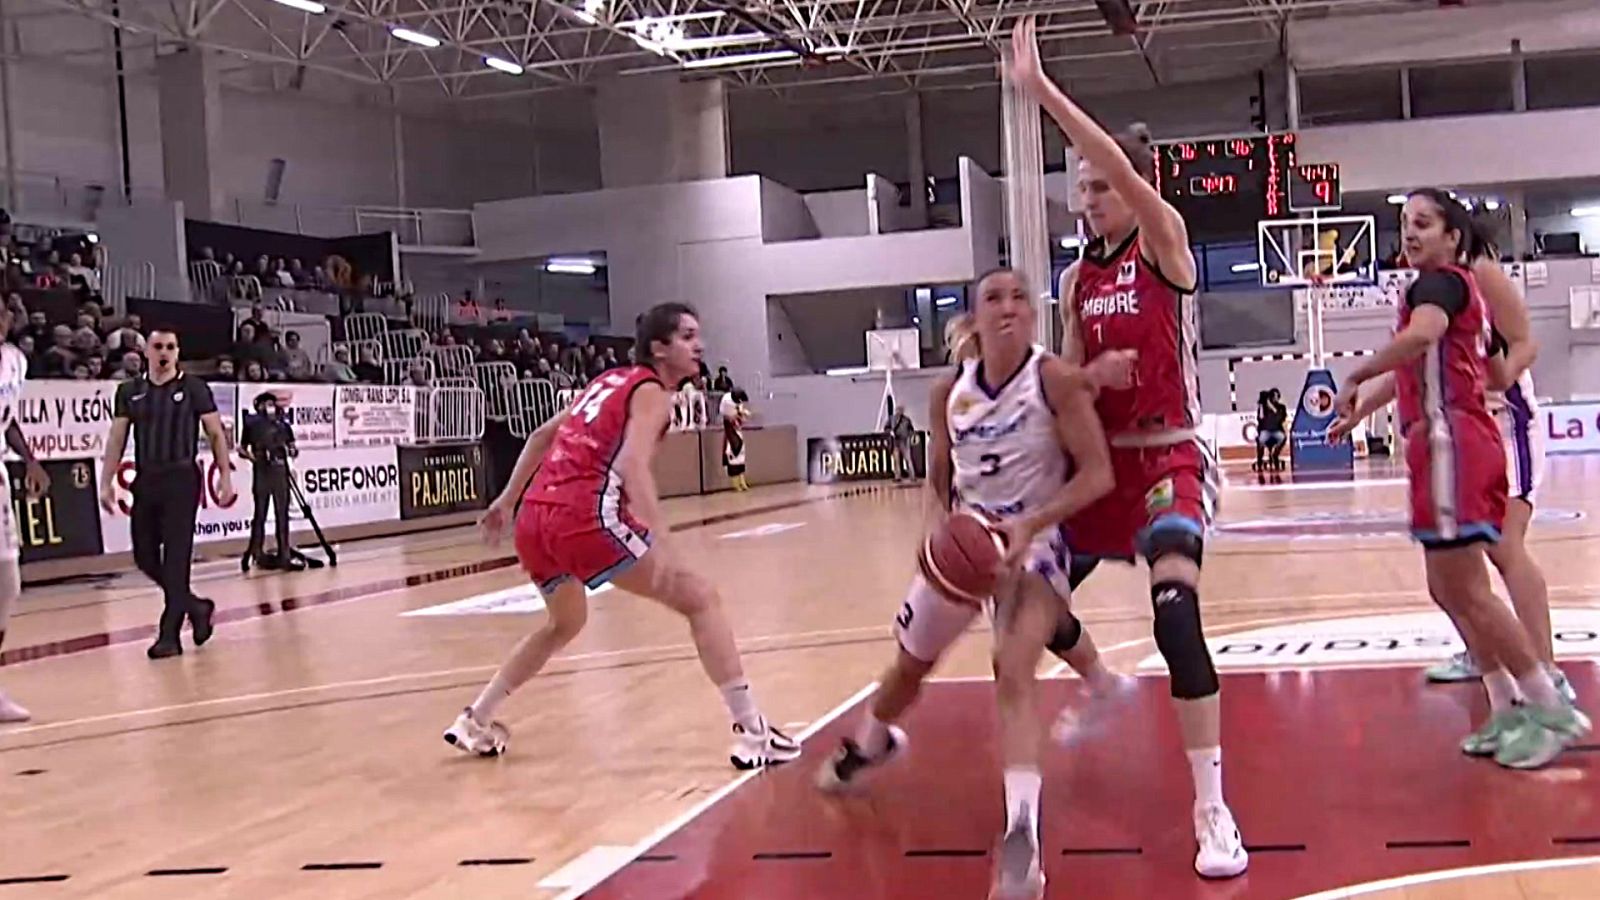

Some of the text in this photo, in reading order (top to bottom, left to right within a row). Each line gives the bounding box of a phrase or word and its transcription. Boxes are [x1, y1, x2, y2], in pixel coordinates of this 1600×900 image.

[1315, 181, 1330, 204] 9
[1081, 289, 1140, 317] MBIBRE
[570, 382, 617, 424] 14
[1548, 411, 1584, 440] La
[980, 453, 1001, 476] 3
[304, 464, 397, 494] SERFONOR
[411, 466, 478, 507] PAJARIEL
[222, 520, 242, 536] you
[896, 602, 914, 629] 3
